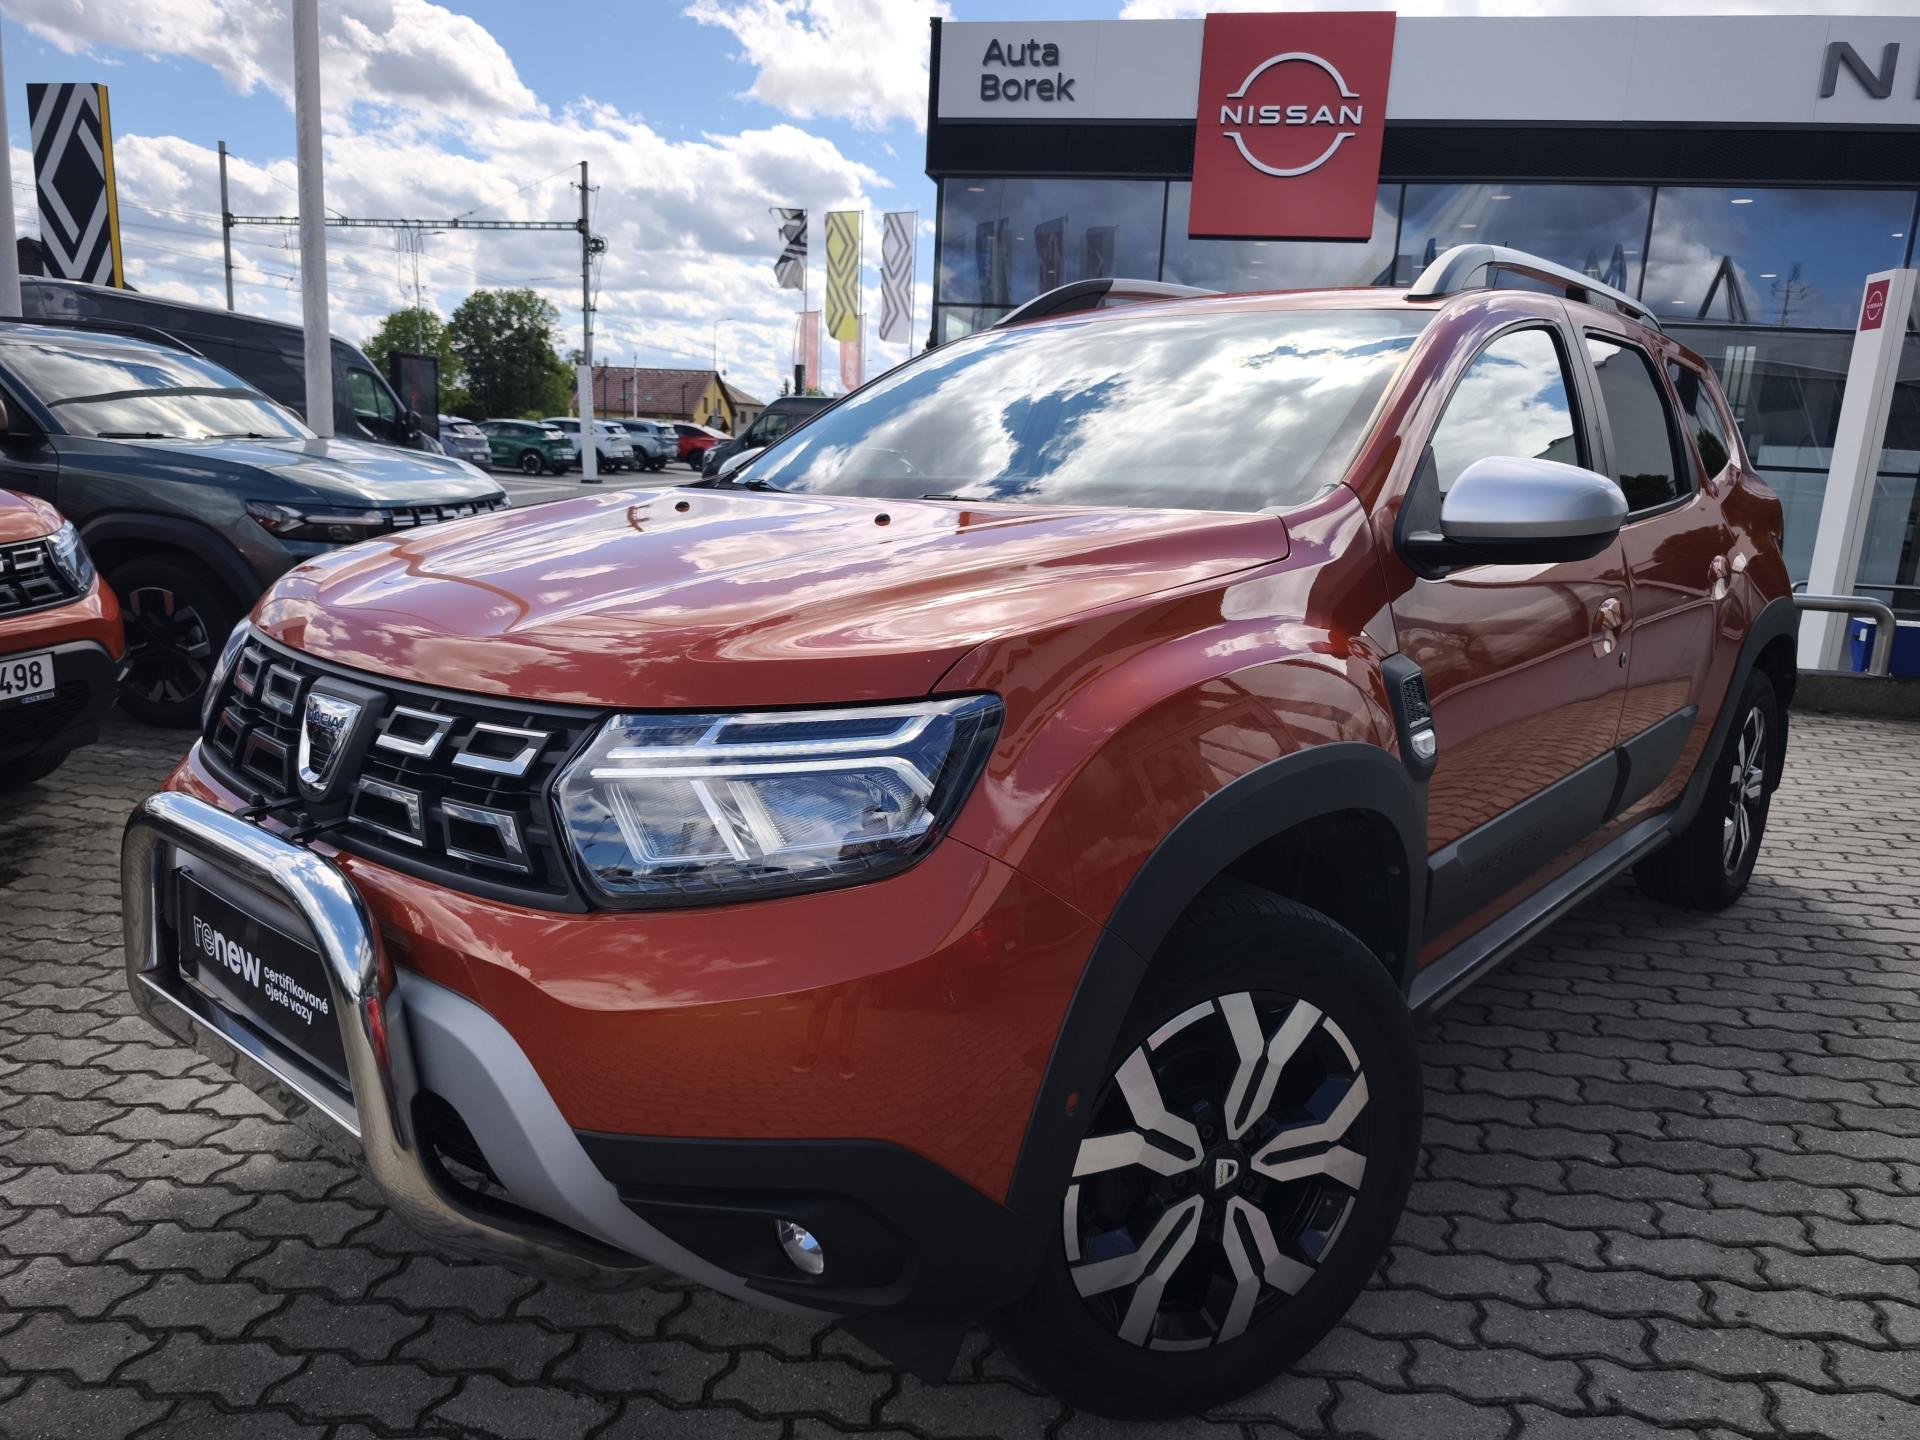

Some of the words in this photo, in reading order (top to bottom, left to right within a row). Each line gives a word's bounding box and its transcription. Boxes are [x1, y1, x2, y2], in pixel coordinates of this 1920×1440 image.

[982, 38, 1059, 67] Auta
[981, 72, 1075, 102] Borek
[1220, 105, 1363, 125] NISSAN
[193, 915, 261, 988] renew
[264, 966, 329, 1015] certifikované
[265, 982, 289, 1008] ojeté
[289, 998, 313, 1026] vozy
